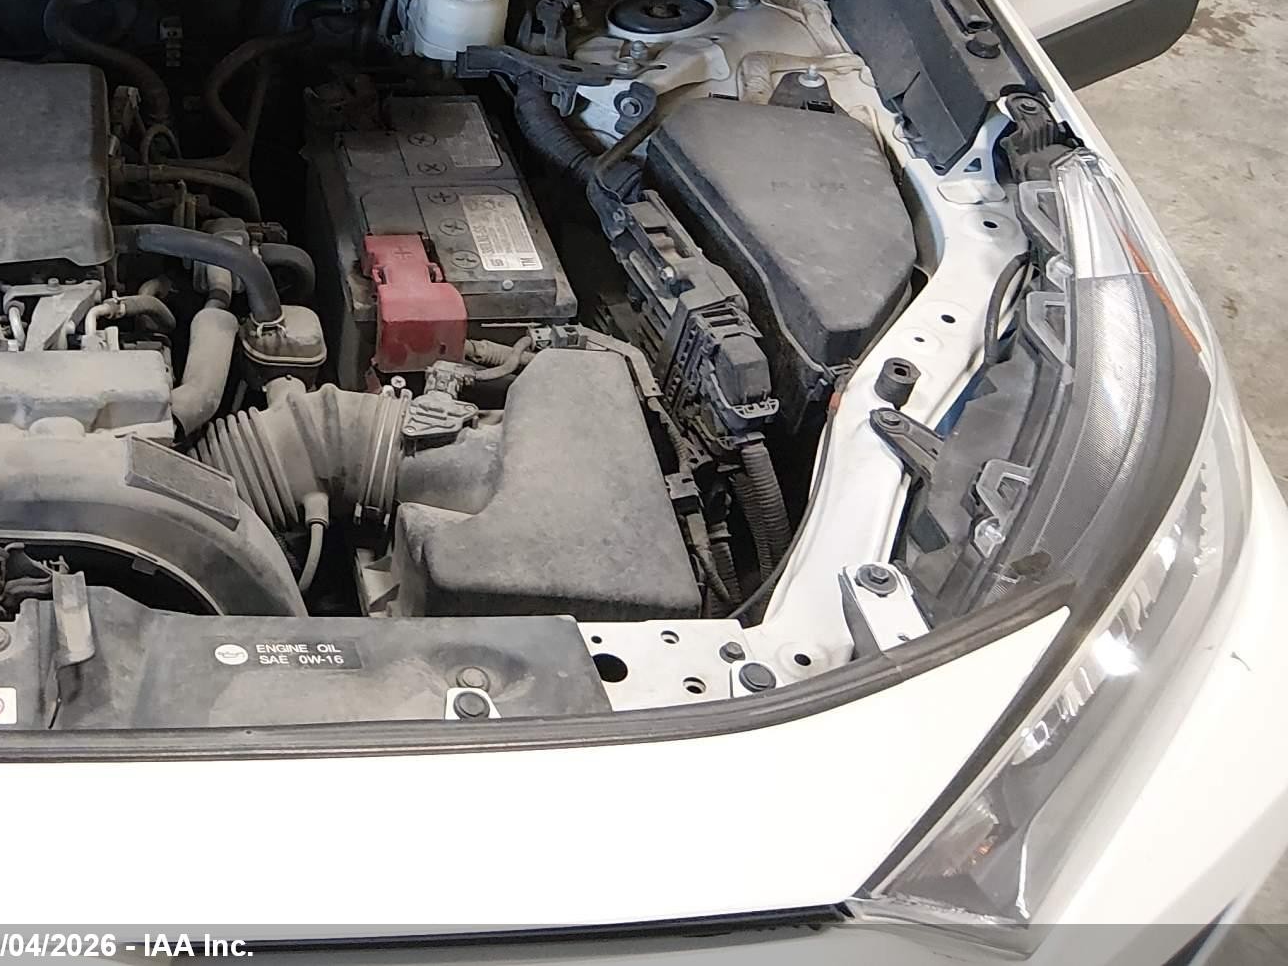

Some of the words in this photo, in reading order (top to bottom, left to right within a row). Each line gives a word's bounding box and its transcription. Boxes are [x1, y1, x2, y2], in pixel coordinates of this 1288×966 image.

[255, 643, 308, 654] ENGINE
[317, 643, 342, 654] OIL
[259, 654, 290, 665] SAE
[299, 654, 345, 665] 0W-16
